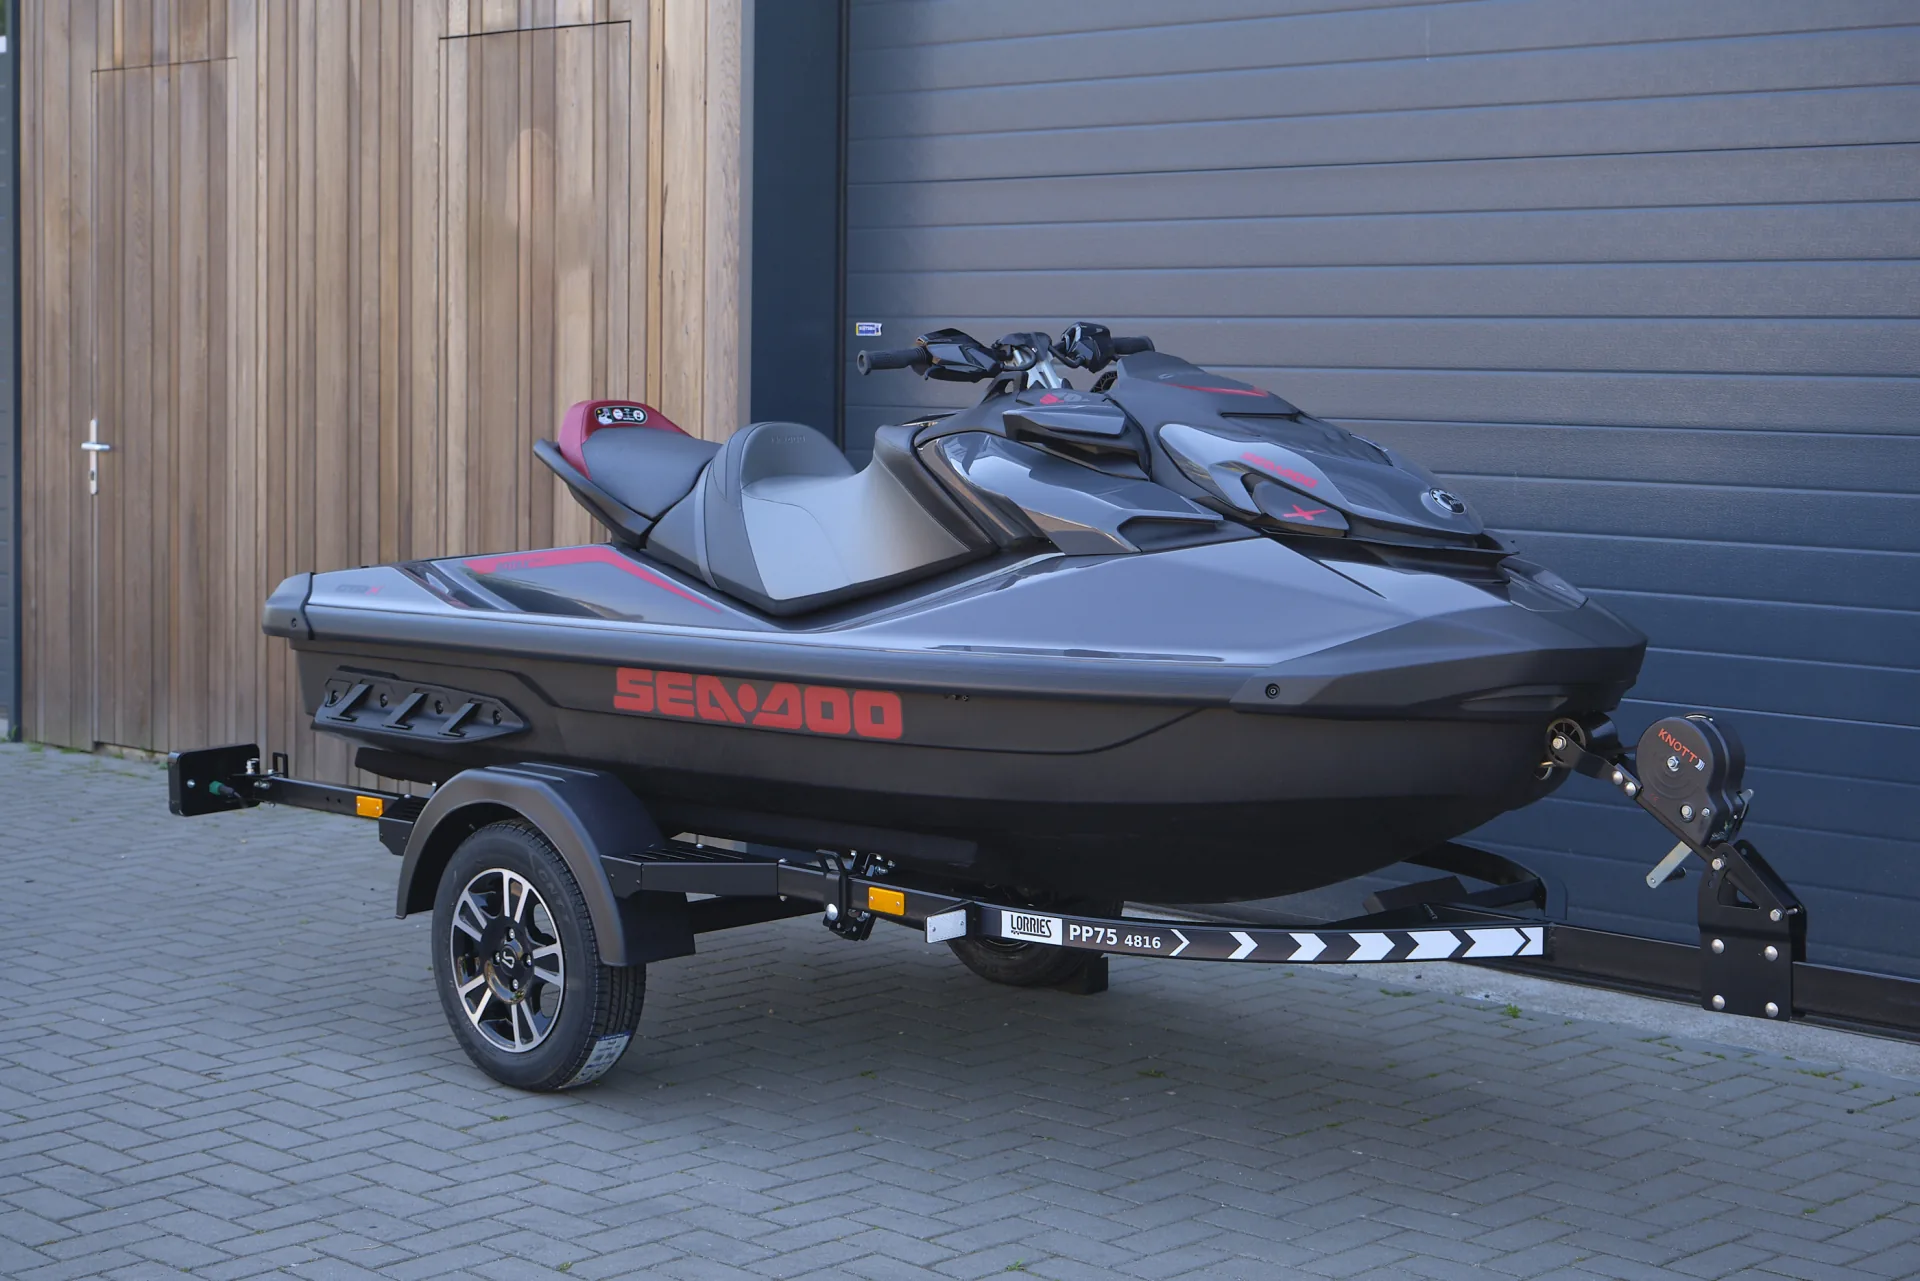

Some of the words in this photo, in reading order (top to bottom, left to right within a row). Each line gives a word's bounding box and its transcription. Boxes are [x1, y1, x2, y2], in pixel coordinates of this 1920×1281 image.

[1658, 727, 1698, 763] KNOTT
[1011, 914, 1052, 938] LORRIES
[1069, 924, 1118, 945] PP75
[1124, 934, 1161, 949] 4816
